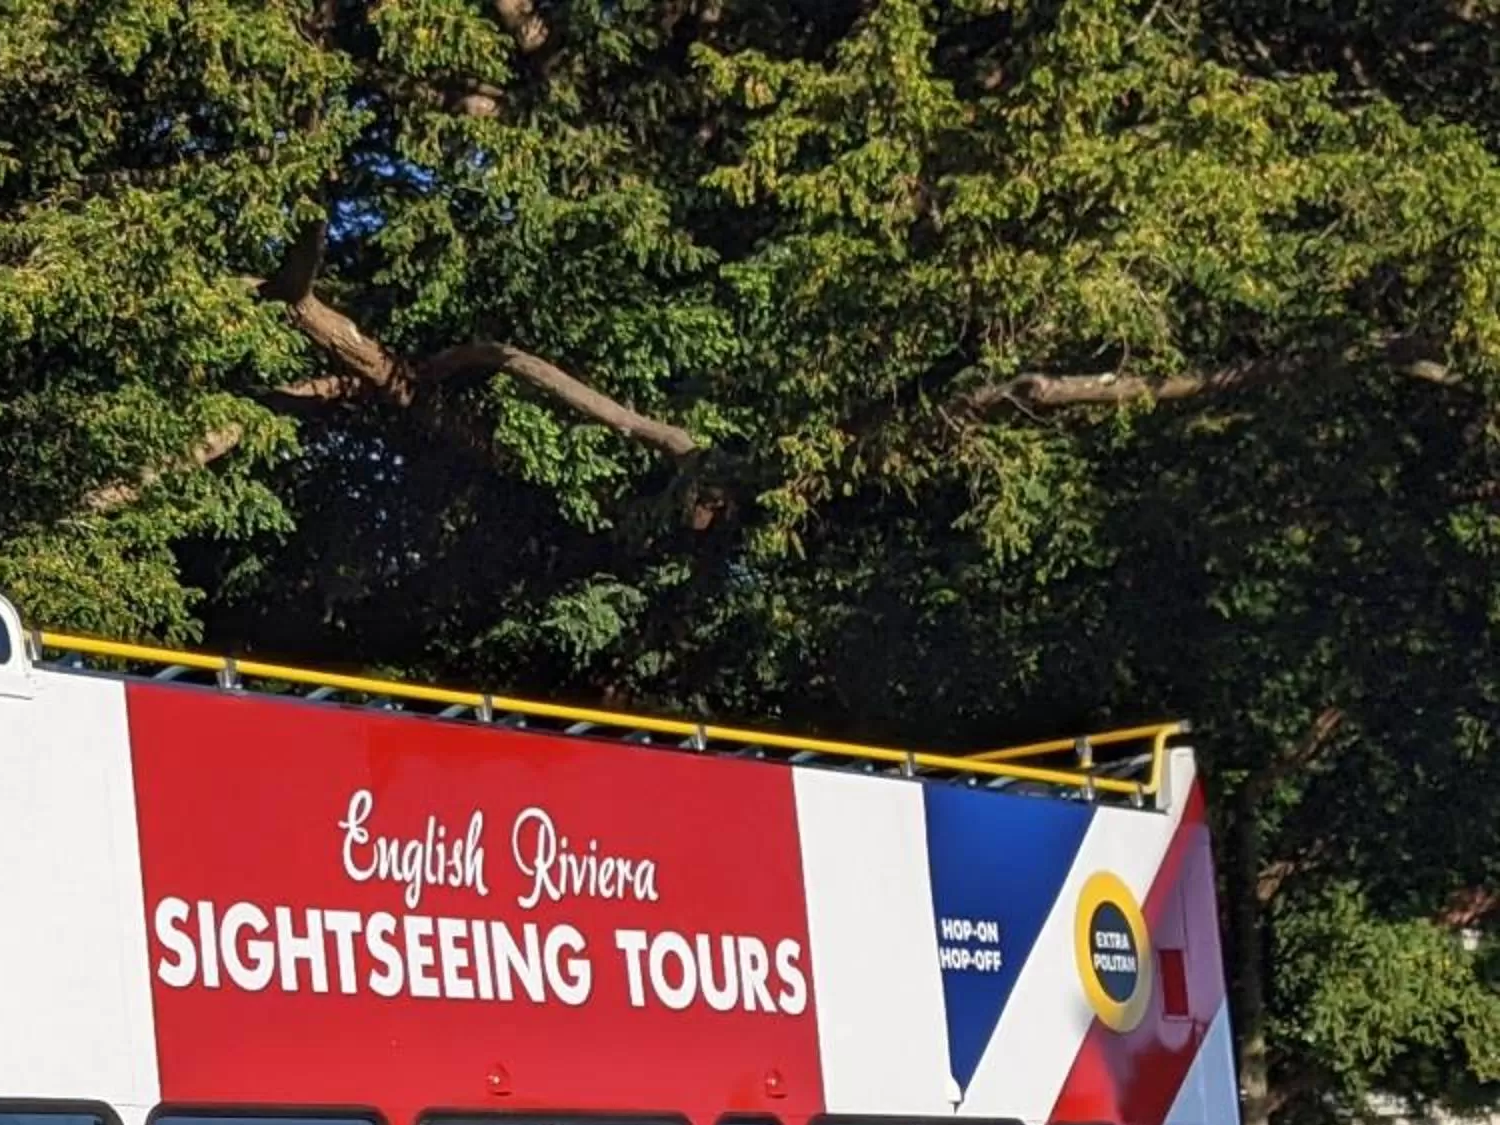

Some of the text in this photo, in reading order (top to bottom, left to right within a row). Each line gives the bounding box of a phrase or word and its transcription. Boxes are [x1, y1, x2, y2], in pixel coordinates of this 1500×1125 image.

[338, 789, 659, 909] English Riviera
[941, 918, 999, 944] HOP-ON
[1095, 931, 1130, 950] EXTRA
[154, 897, 808, 1015] SIGHTSEEING TOURS
[939, 947, 1001, 972] HOP-OFF
